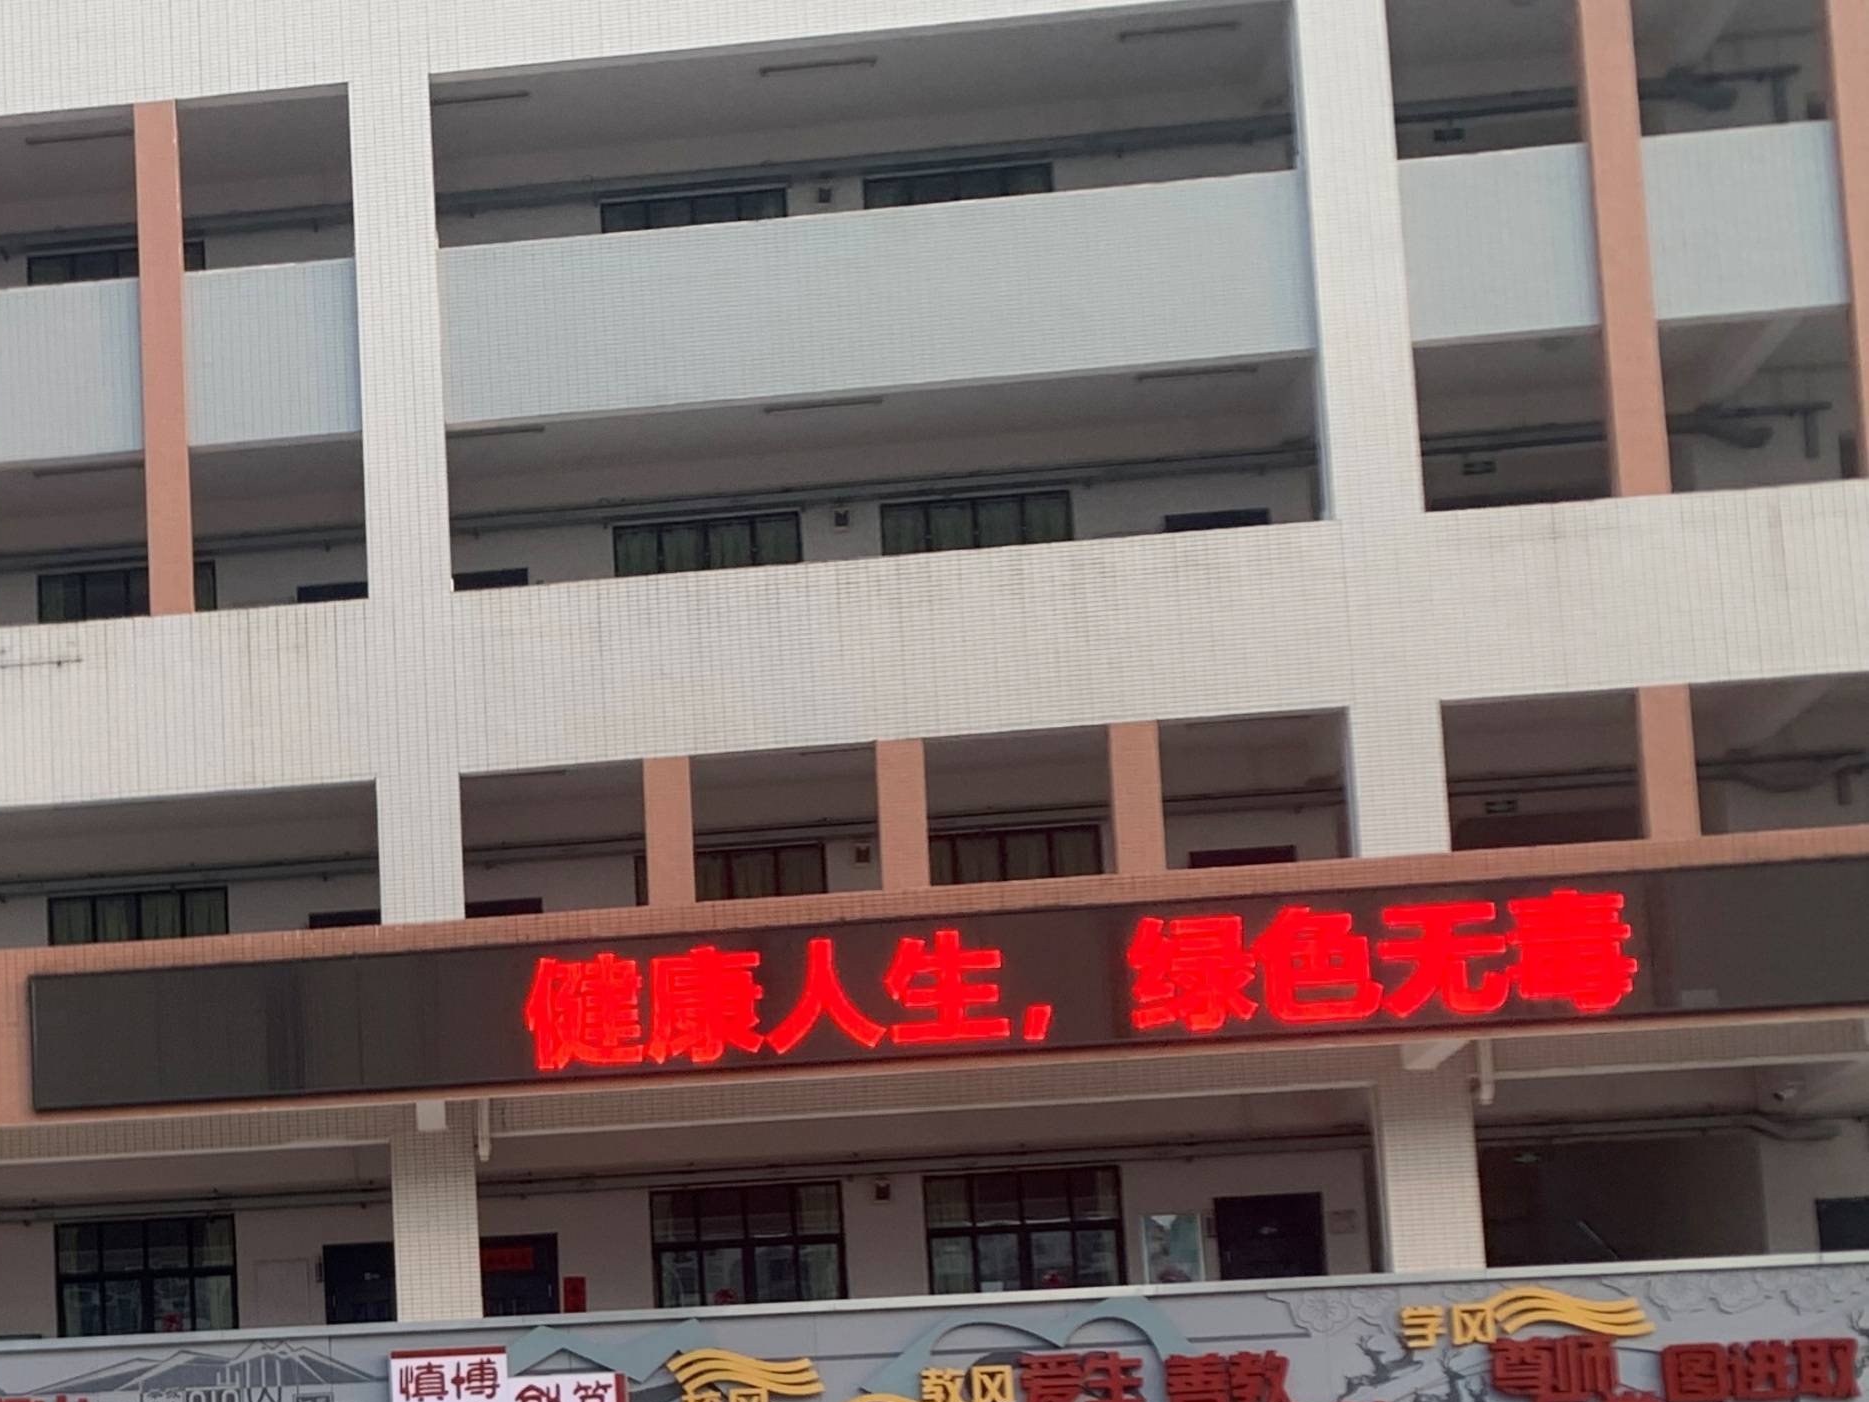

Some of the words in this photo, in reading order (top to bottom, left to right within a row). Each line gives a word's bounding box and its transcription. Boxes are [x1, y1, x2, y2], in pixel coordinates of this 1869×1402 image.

[1398, 1303, 1497, 1348] 学风
[1489, 1334, 1620, 1402] 尊师
[1661, 1338, 1860, 1402] 图进取
